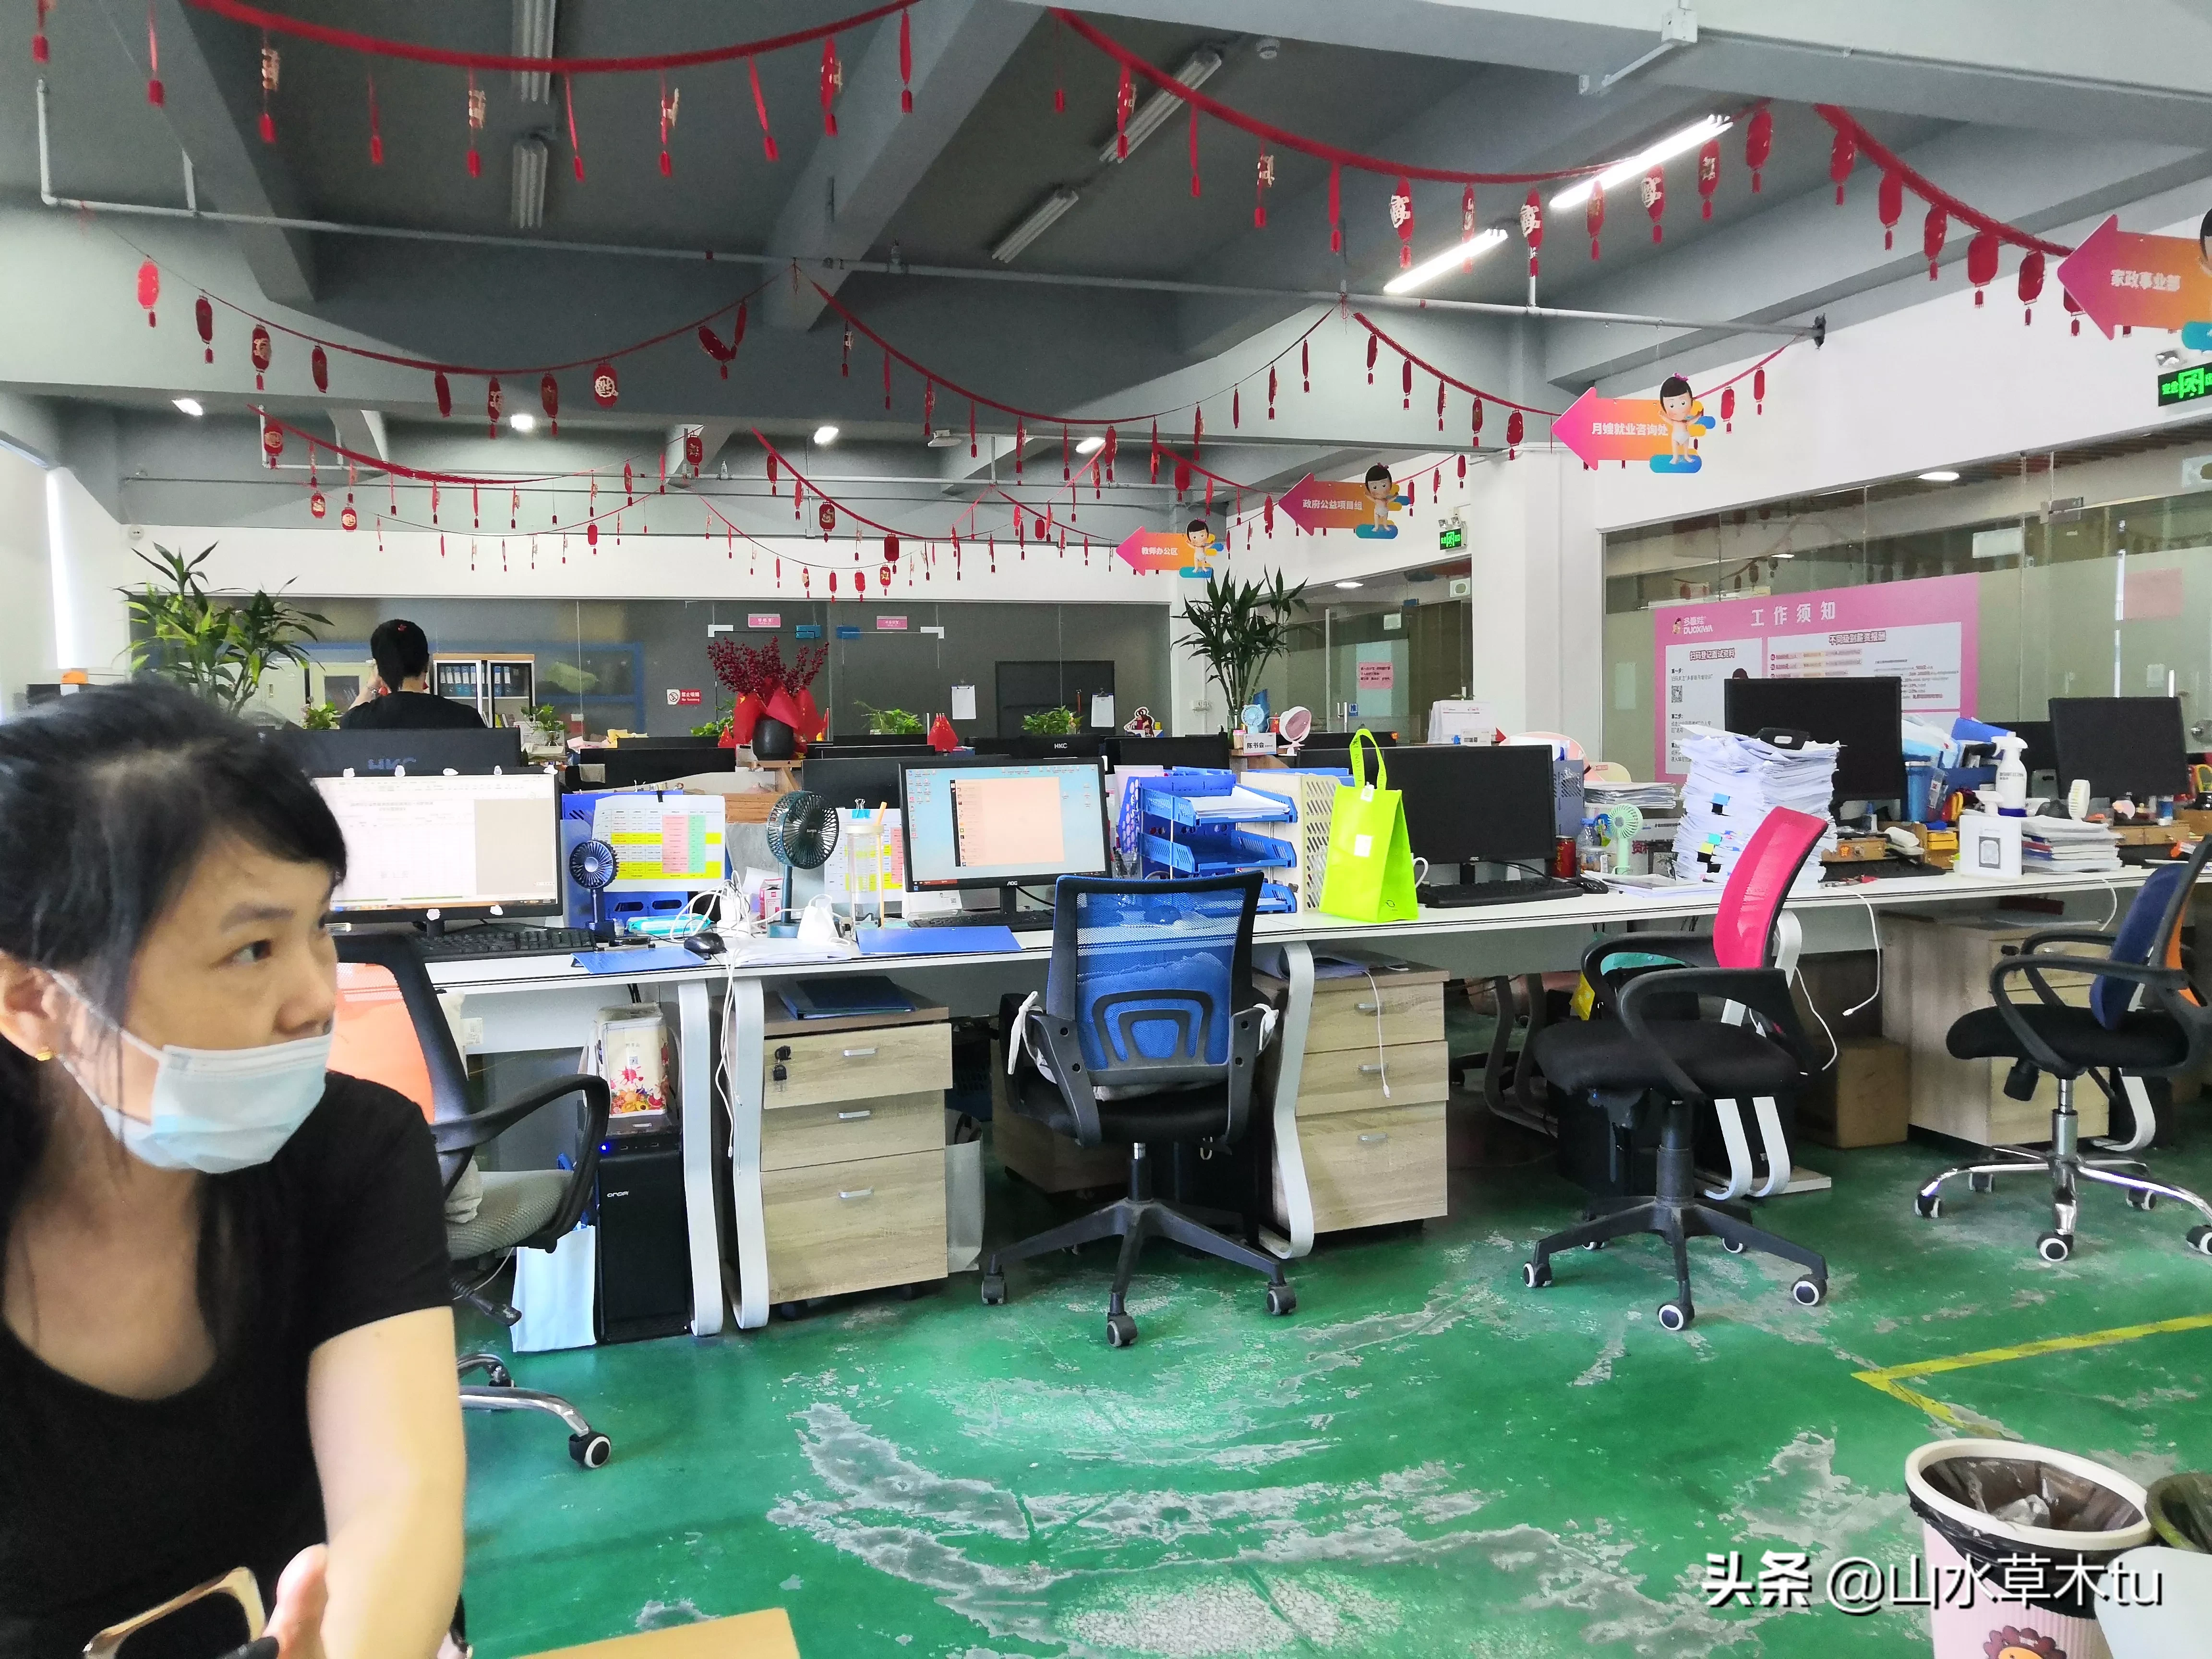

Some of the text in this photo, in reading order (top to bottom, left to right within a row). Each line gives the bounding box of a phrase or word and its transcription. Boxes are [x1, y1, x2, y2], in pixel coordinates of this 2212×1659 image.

[1592, 422, 1669, 436] 月嫂就业咨询处
[1302, 499, 1363, 511] 政府公益项目组
[1141, 547, 1178, 555] 教师办公区
[1751, 601, 1836, 626] 工作须知
